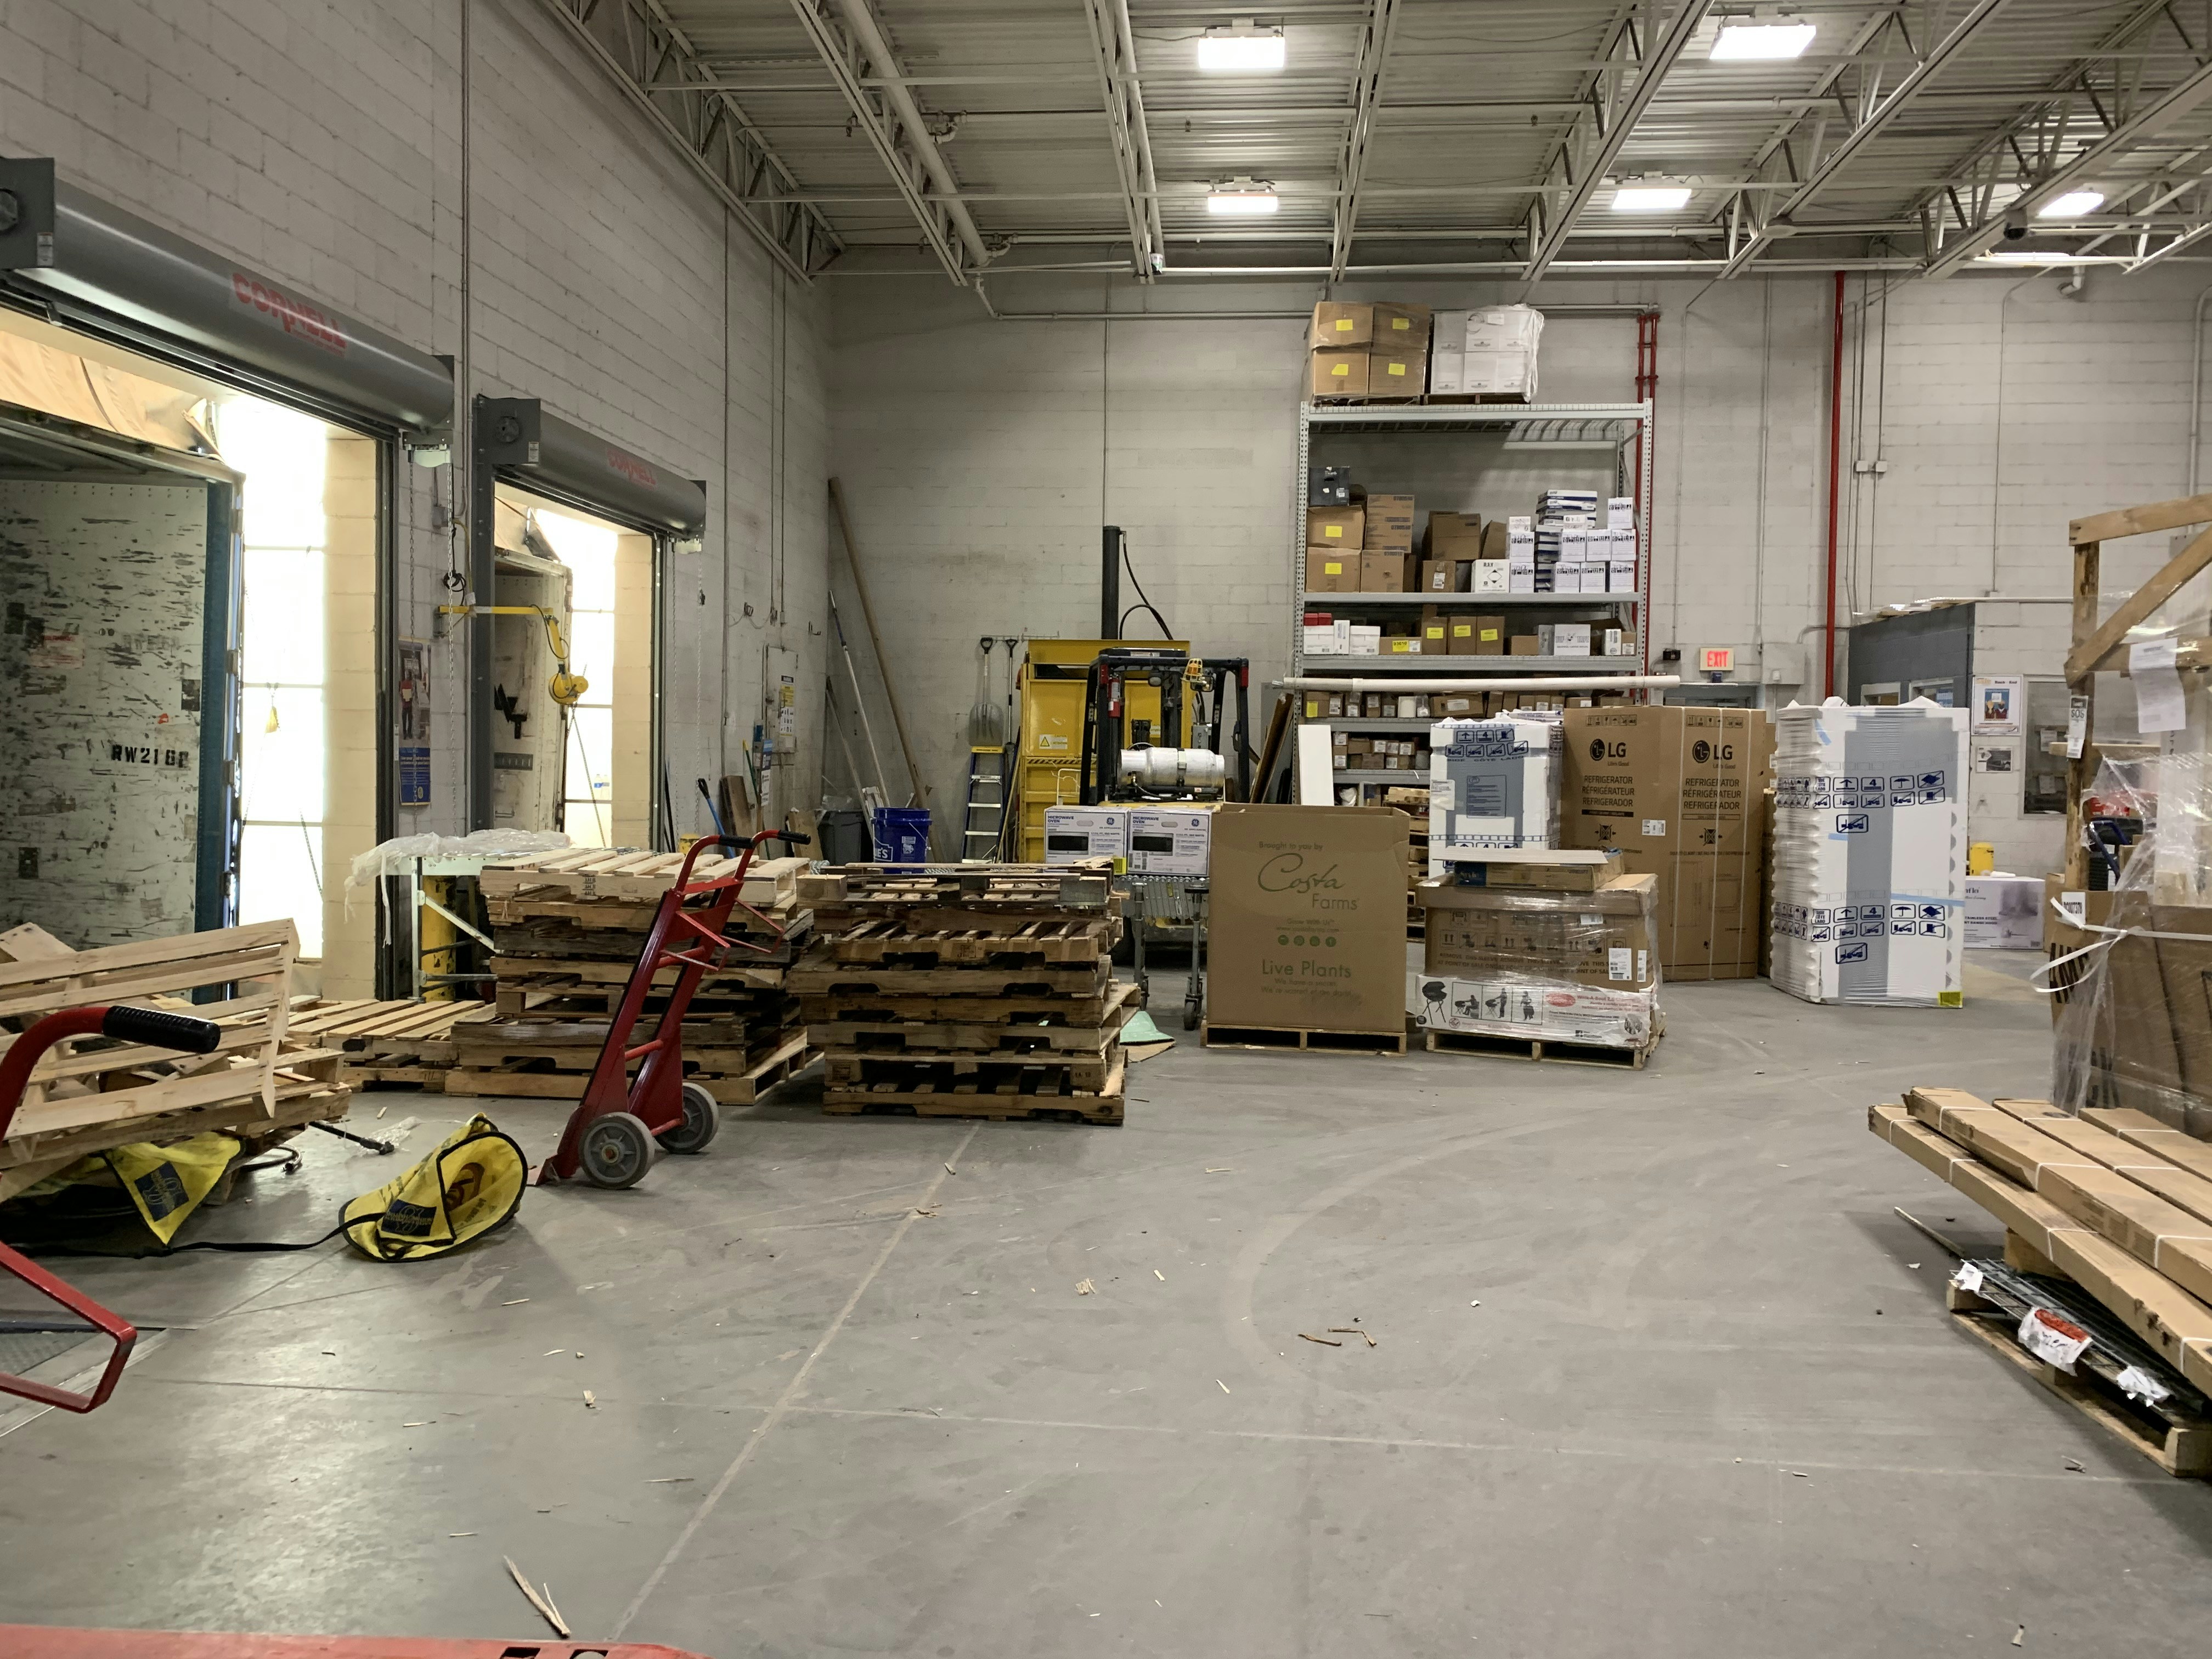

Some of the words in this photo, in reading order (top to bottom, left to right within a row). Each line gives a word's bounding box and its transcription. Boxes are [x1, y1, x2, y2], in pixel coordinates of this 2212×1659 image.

[233, 273, 347, 349] CORNELL
[1707, 650, 1729, 667] EXIT
[2071, 709, 2085, 719] SOS
[1607, 742, 1627, 758] LG
[1713, 744, 1733, 760] LG
[1584, 775, 1633, 785] REFRIGERATOR
[1582, 785, 1635, 796] RÉFRIGÉRATEUR
[1582, 797, 1633, 807] REFRIGERADOR
[1259, 841, 1287, 850] Brought
[1314, 842, 1323, 851] by
[1257, 852, 1346, 894] Costa
[1312, 893, 1358, 910] Farms
[1262, 959, 1294, 975] Live
[1301, 960, 1351, 979] Plants
